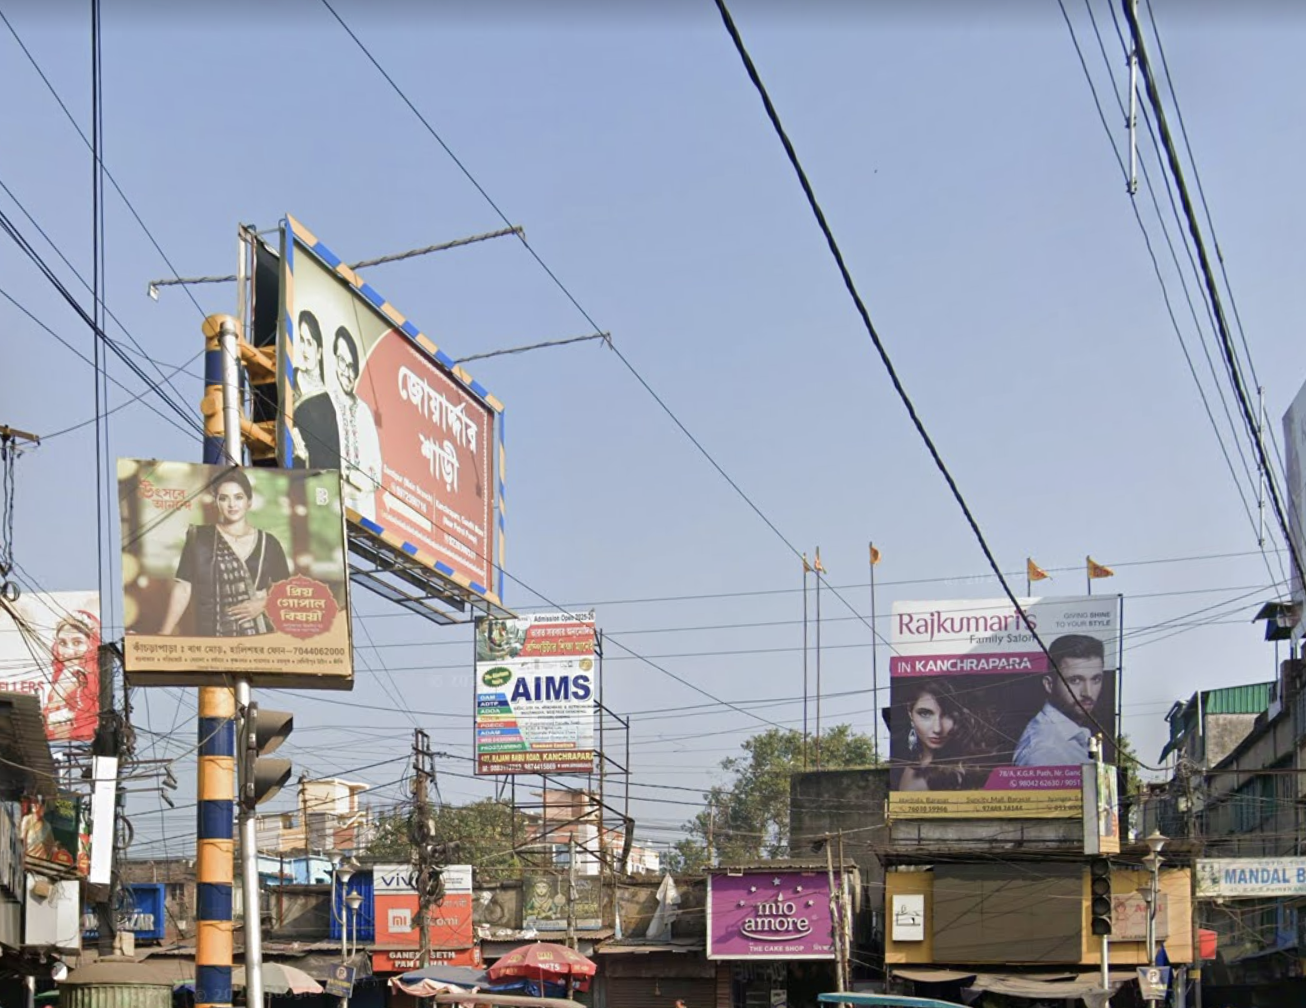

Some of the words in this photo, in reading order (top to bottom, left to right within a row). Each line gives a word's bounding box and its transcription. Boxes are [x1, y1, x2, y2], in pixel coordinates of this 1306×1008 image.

[277, 598, 326, 608] গোপাল
[898, 609, 1037, 641] Rajkumari's
[969, 634, 1004, 645] Family
[1006, 633, 1036, 643] Salon
[898, 661, 911, 672] IN
[915, 656, 1032, 672] KANCHRAPARA
[511, 675, 591, 702] AIMS
[1224, 867, 1291, 885] MANDAL
[757, 897, 796, 915] mio
[744, 917, 809, 931] amore
[389, 951, 420, 959] GANES
